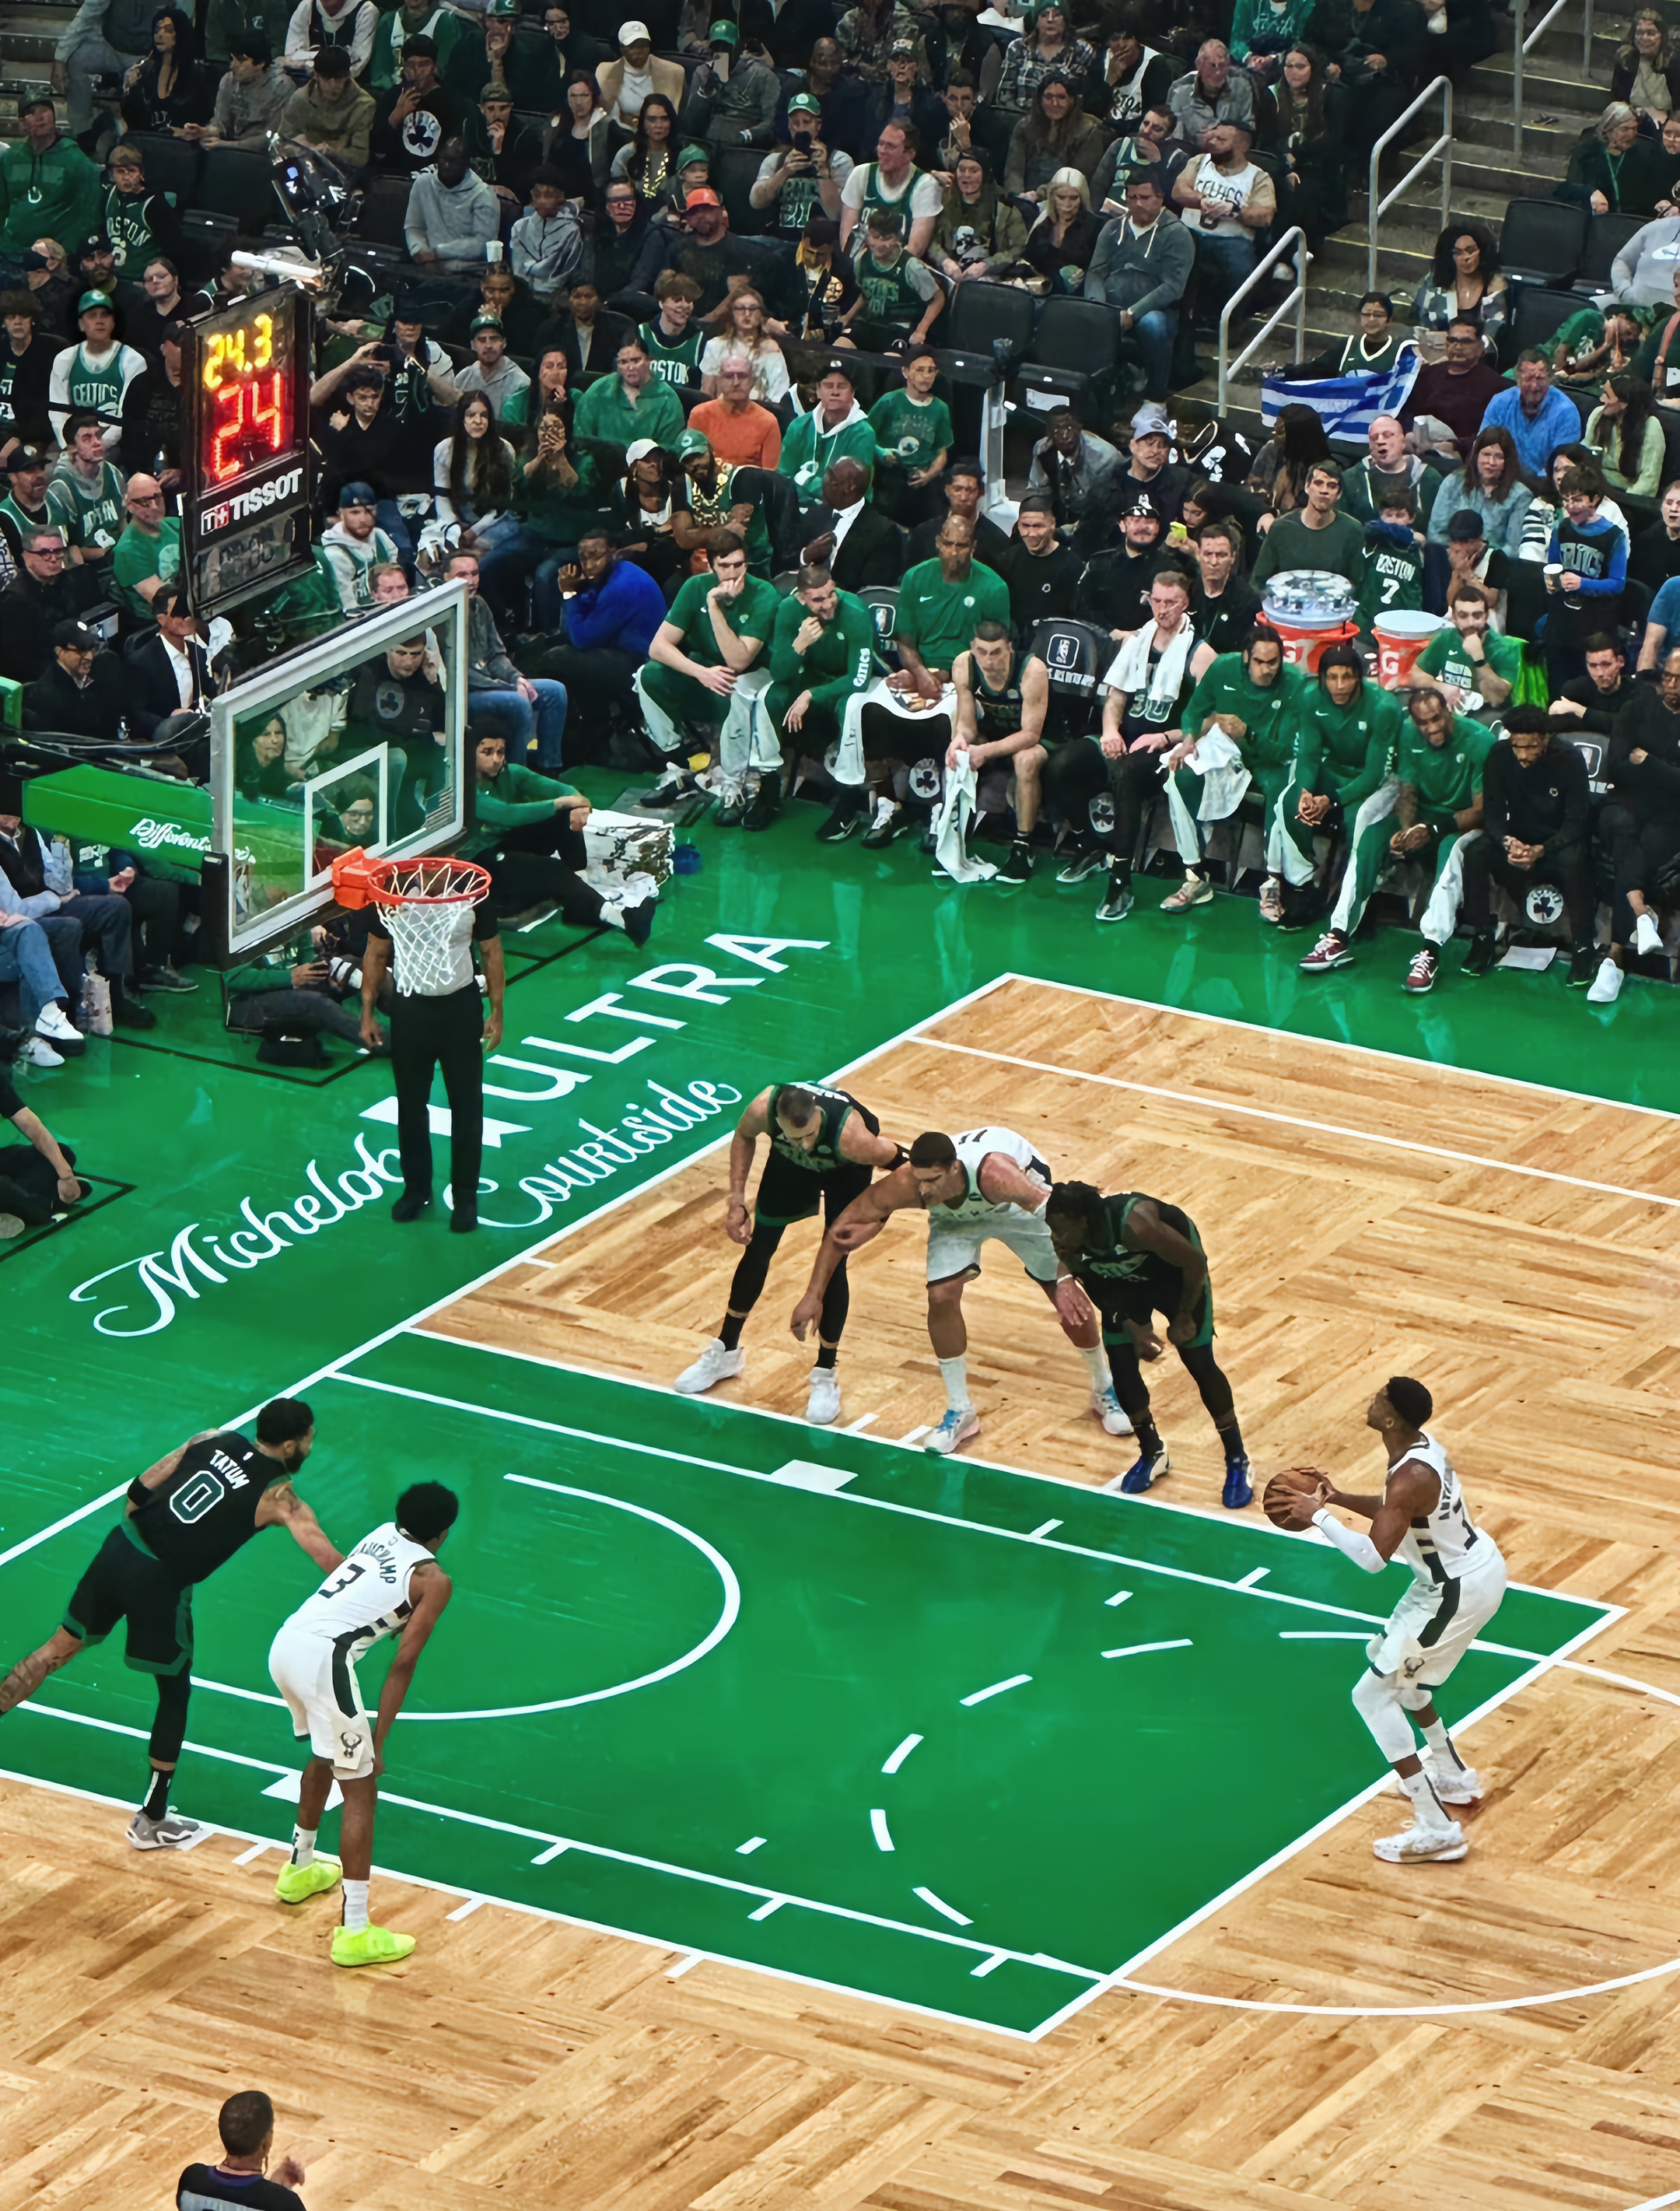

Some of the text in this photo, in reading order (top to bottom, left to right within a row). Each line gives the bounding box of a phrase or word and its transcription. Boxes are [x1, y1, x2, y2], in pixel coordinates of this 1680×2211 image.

[203, 313, 272, 389] 24.3
[649, 359, 690, 384] OSTON
[212, 371, 282, 481] 24
[229, 467, 304, 520] TISSOT
[1380, 577, 1401, 604] 7
[1381, 650, 1400, 675] G
[68, 933, 831, 1337] Michelob ULTRA
[442, 1078, 743, 1228] Courtside
[209, 1449, 250, 1490] TATUM
[169, 1470, 225, 1524] 0
[317, 1562, 367, 1600] 3
